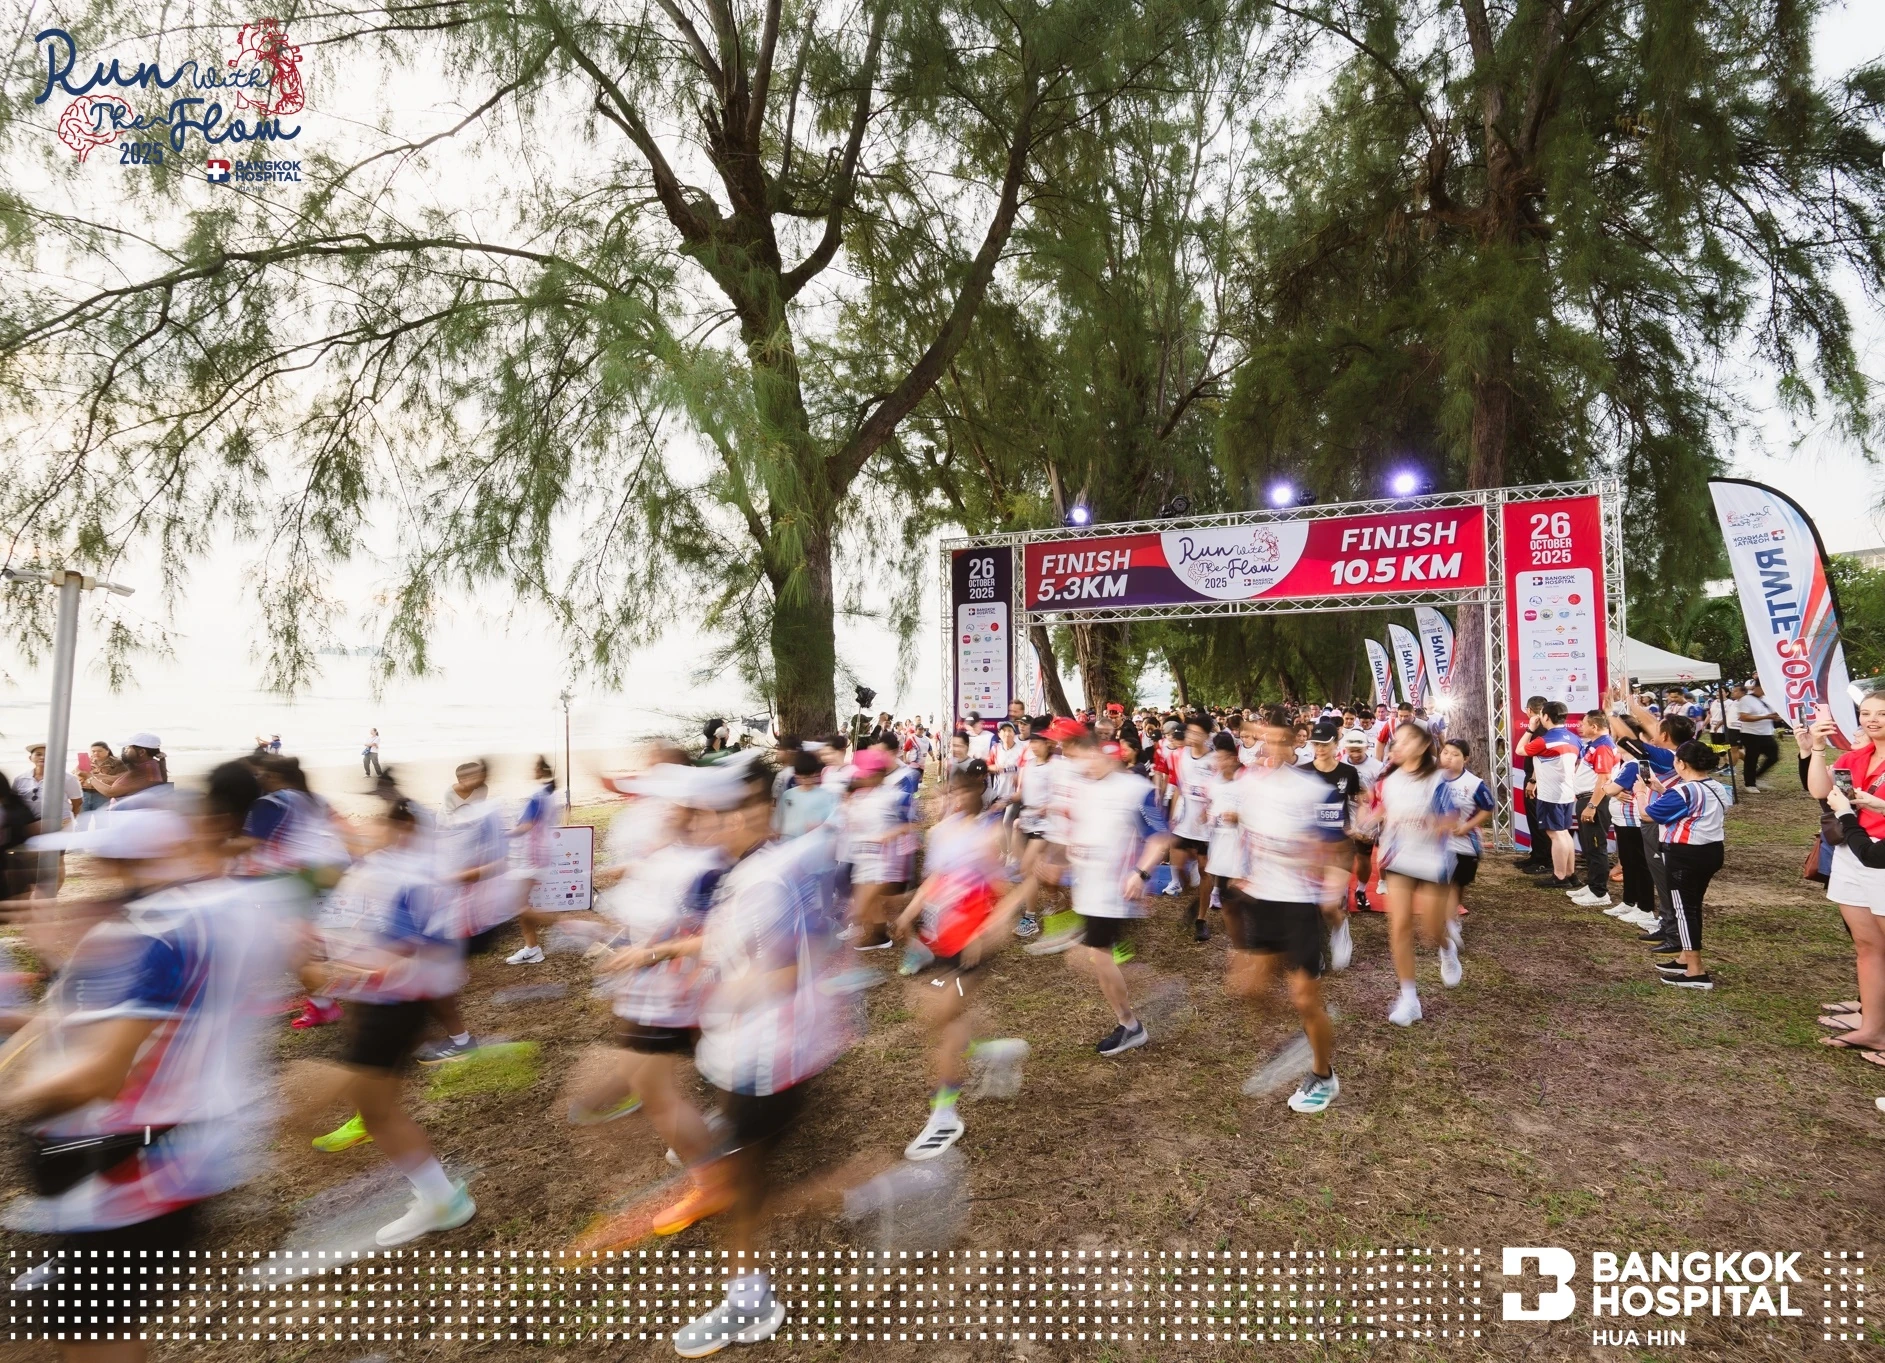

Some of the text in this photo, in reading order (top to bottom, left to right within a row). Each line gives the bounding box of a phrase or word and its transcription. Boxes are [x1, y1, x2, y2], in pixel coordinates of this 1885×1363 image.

[1530, 511, 1571, 539] 26
[1341, 520, 1458, 552] FINISH
[1530, 538, 1572, 550] OCTOBER
[1179, 537, 1232, 565] Run
[1531, 550, 1572, 565] 2025
[969, 557, 995, 579] 26
[1041, 549, 1131, 576] FINISH
[1199, 562, 1223, 573] The
[1330, 552, 1462, 585] 10.5 KM
[968, 578, 995, 588] OCTOBER
[1037, 574, 1129, 602] 5.3KM
[1204, 577, 1228, 589] 2025
[969, 587, 995, 600] 2025
[1320, 810, 1339, 819] 5609
